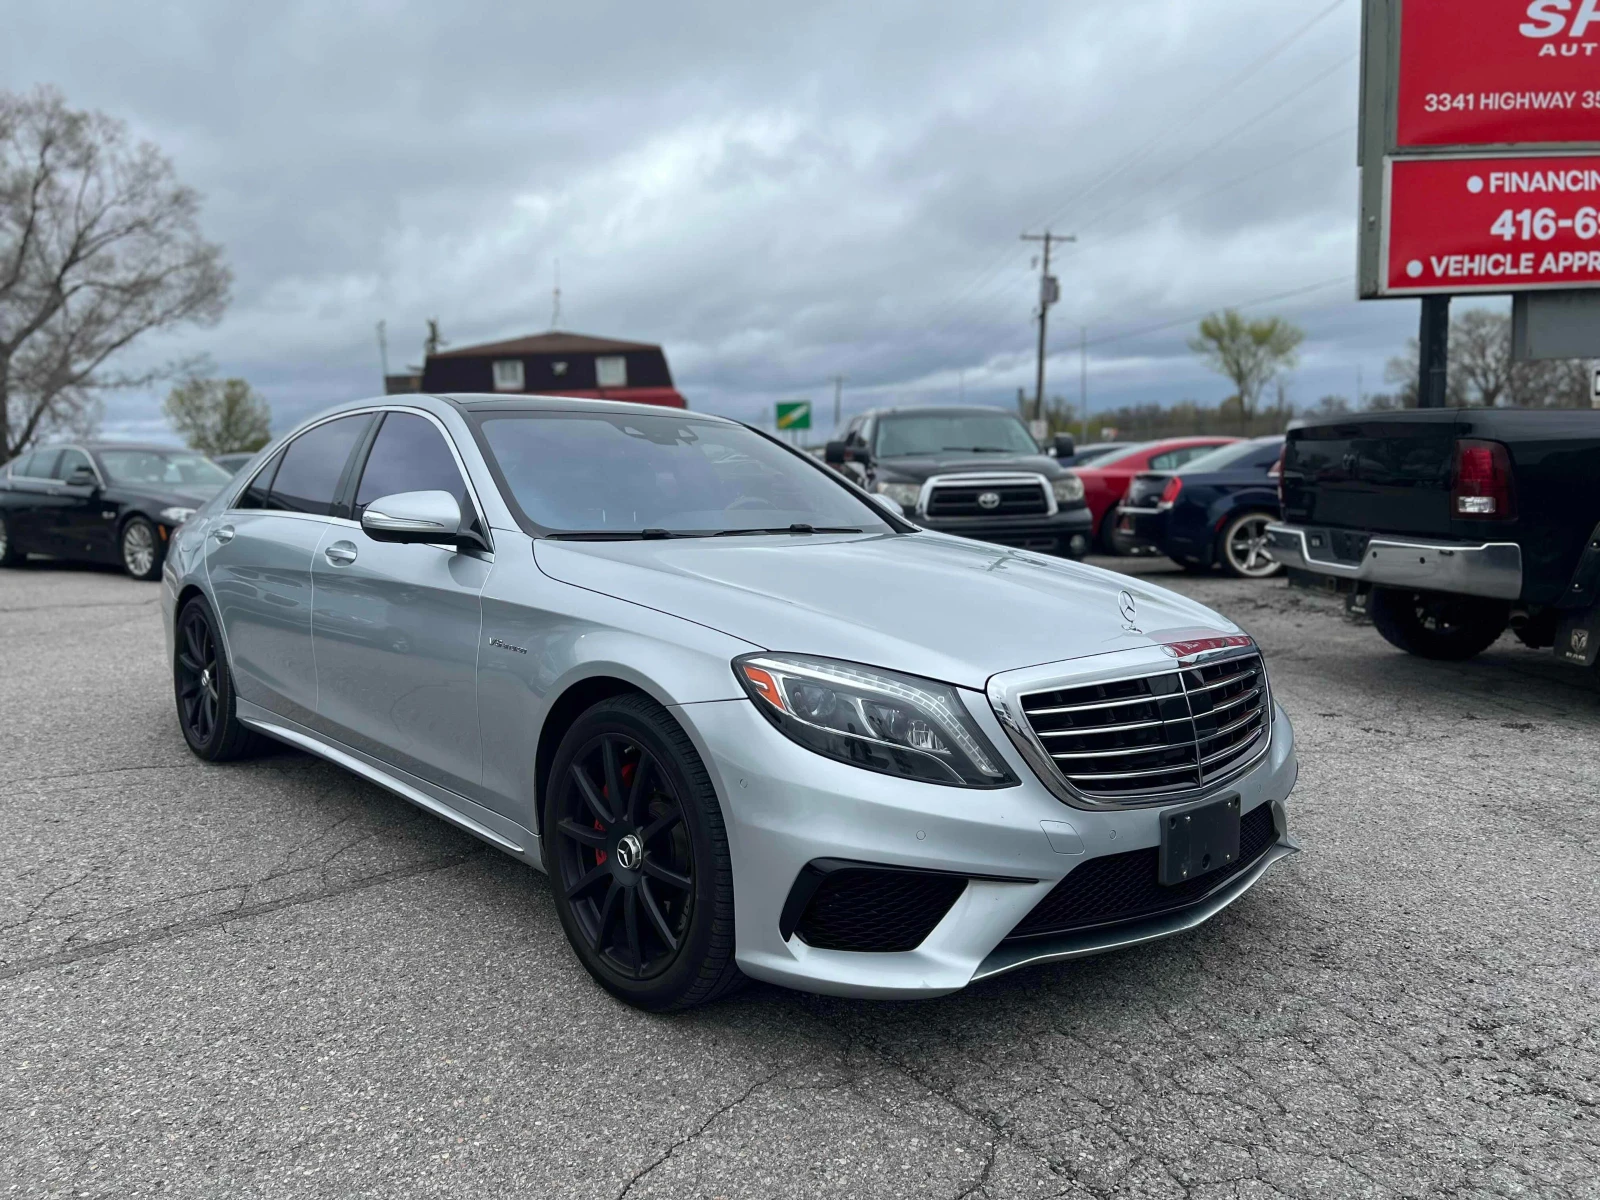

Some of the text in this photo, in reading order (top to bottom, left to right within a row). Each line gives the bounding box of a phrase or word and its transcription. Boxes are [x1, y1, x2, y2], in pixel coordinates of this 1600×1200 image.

[1538, 42, 1598, 57] AUT
[1424, 93, 1475, 112] 3341
[1480, 91, 1577, 110] HIGHWAY
[1490, 206, 1600, 241] 416-6
[1430, 250, 1600, 277] VEHICLE APPR
